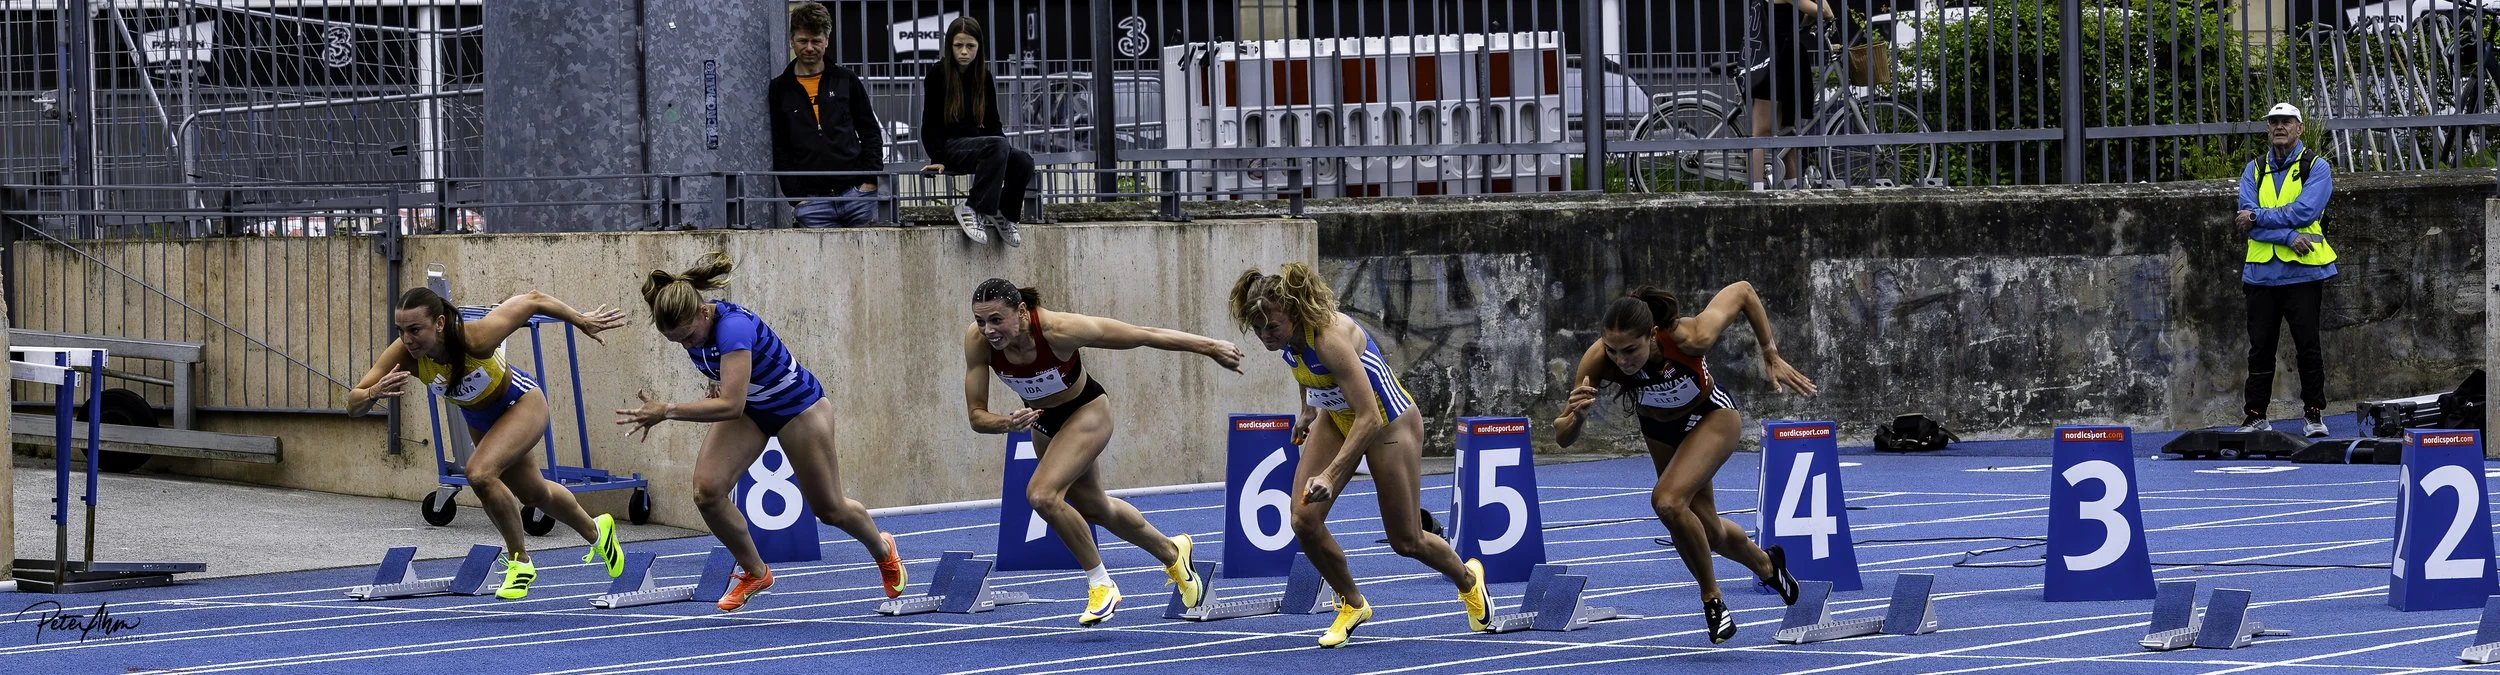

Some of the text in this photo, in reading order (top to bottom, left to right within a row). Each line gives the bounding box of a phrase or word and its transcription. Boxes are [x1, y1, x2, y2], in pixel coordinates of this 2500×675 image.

[899, 31, 946, 40] PARKE
[1025, 386, 1043, 394] IDA
[1239, 421, 1289, 429] nordicsport.com
[1477, 424, 1525, 434] nordicsport.com
[1779, 428, 1830, 438] nordicsport.com
[2064, 431, 2124, 440] nordicsport.com
[2423, 435, 2474, 445] nordicsport.com
[745, 436, 804, 531] 8
[1239, 447, 1296, 552] 6
[1477, 447, 1528, 556] 5
[1774, 451, 1838, 561] 4
[2061, 459, 2132, 572] 3
[2419, 464, 2486, 580] 2
